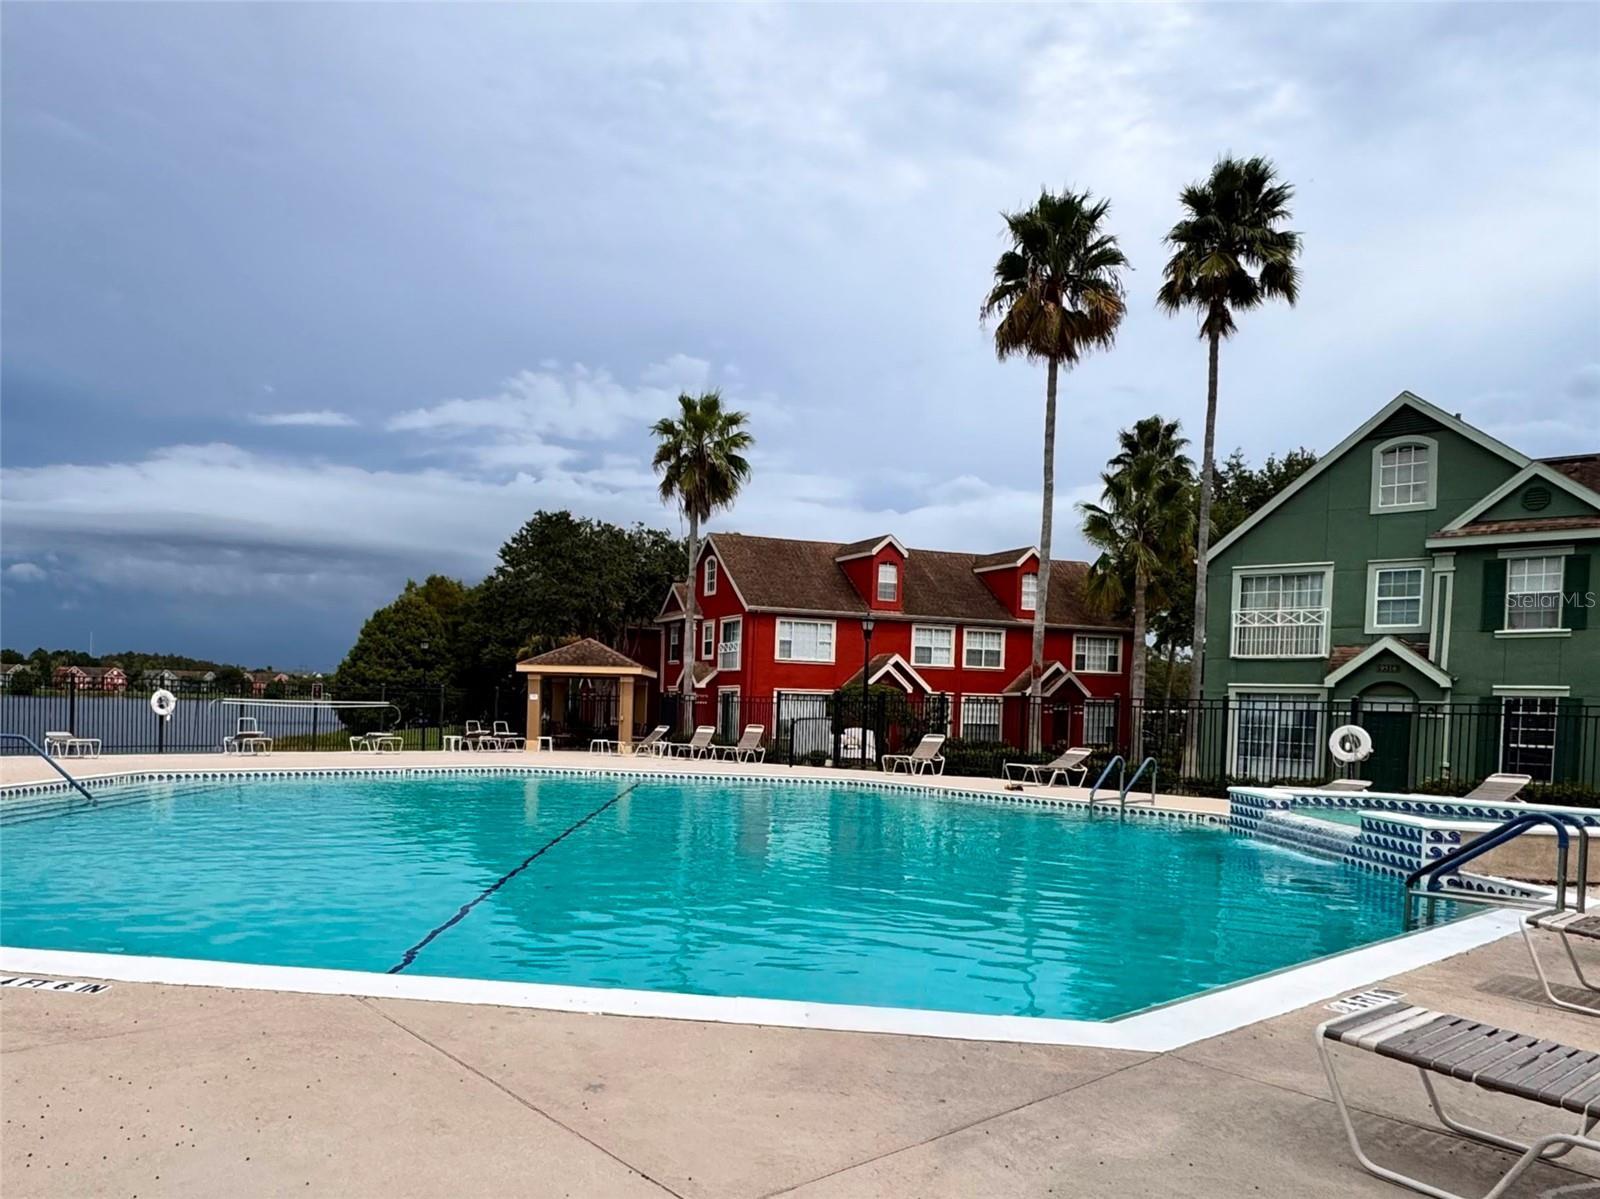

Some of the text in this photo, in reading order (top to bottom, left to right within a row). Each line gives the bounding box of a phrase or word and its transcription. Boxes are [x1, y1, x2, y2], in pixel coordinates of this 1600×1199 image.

[17, 978, 55, 988] FT
[53, 982, 75, 990] 6
[74, 983, 109, 993] IN
